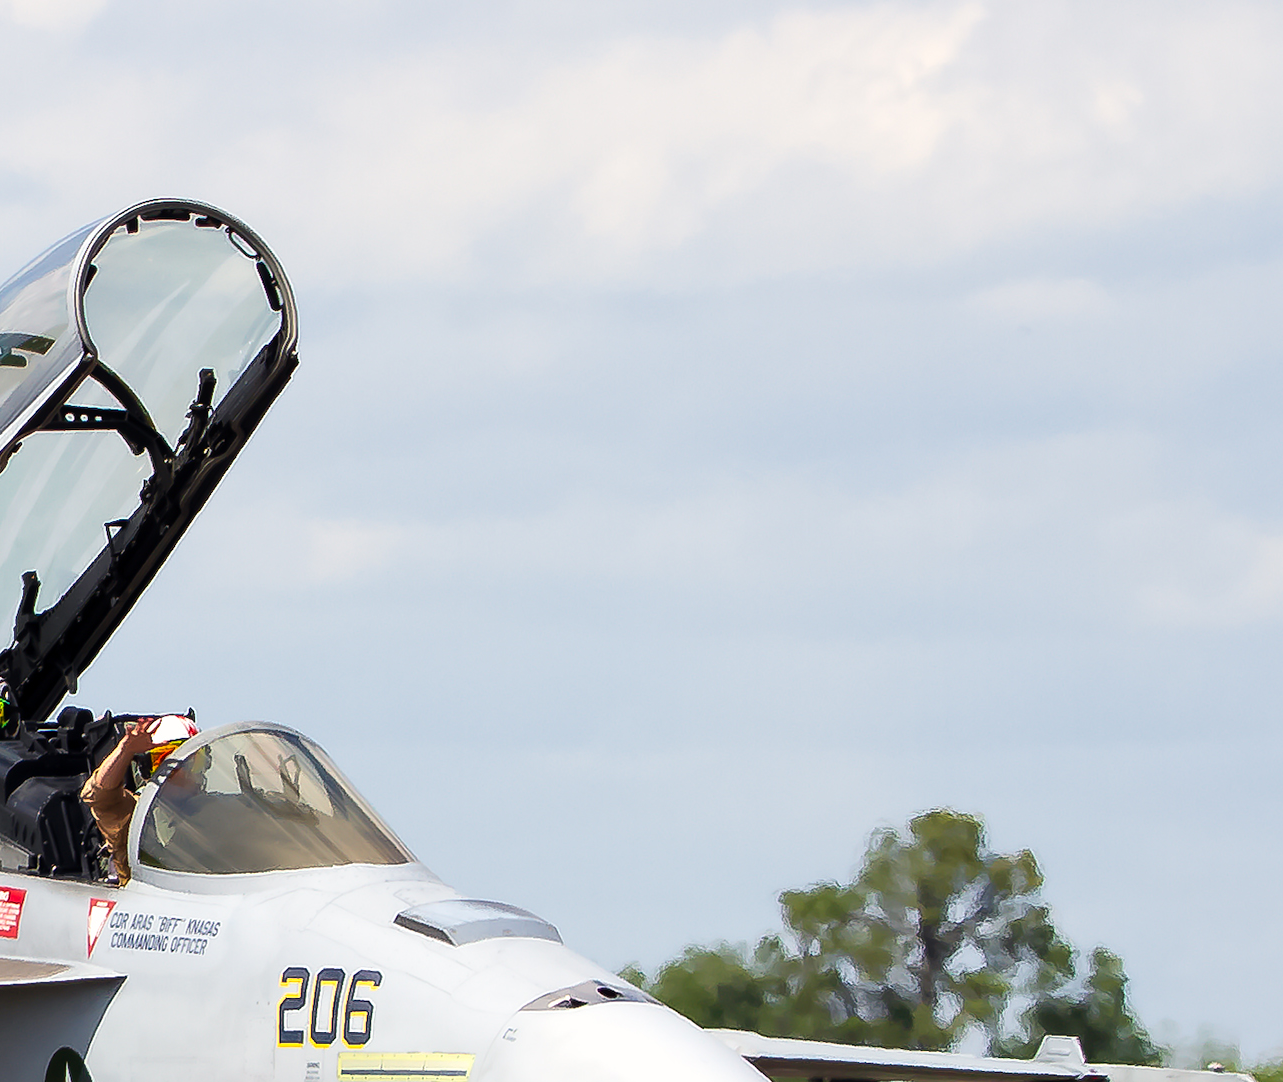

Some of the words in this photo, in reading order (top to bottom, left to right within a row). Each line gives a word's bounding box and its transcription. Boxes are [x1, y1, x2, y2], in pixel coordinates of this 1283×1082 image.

[110, 912, 130, 929] CDR
[130, 913, 154, 931] ARAS
[110, 932, 169, 953] COMMANDING
[170, 936, 208, 955] OFFICER
[276, 966, 383, 1050] 206
